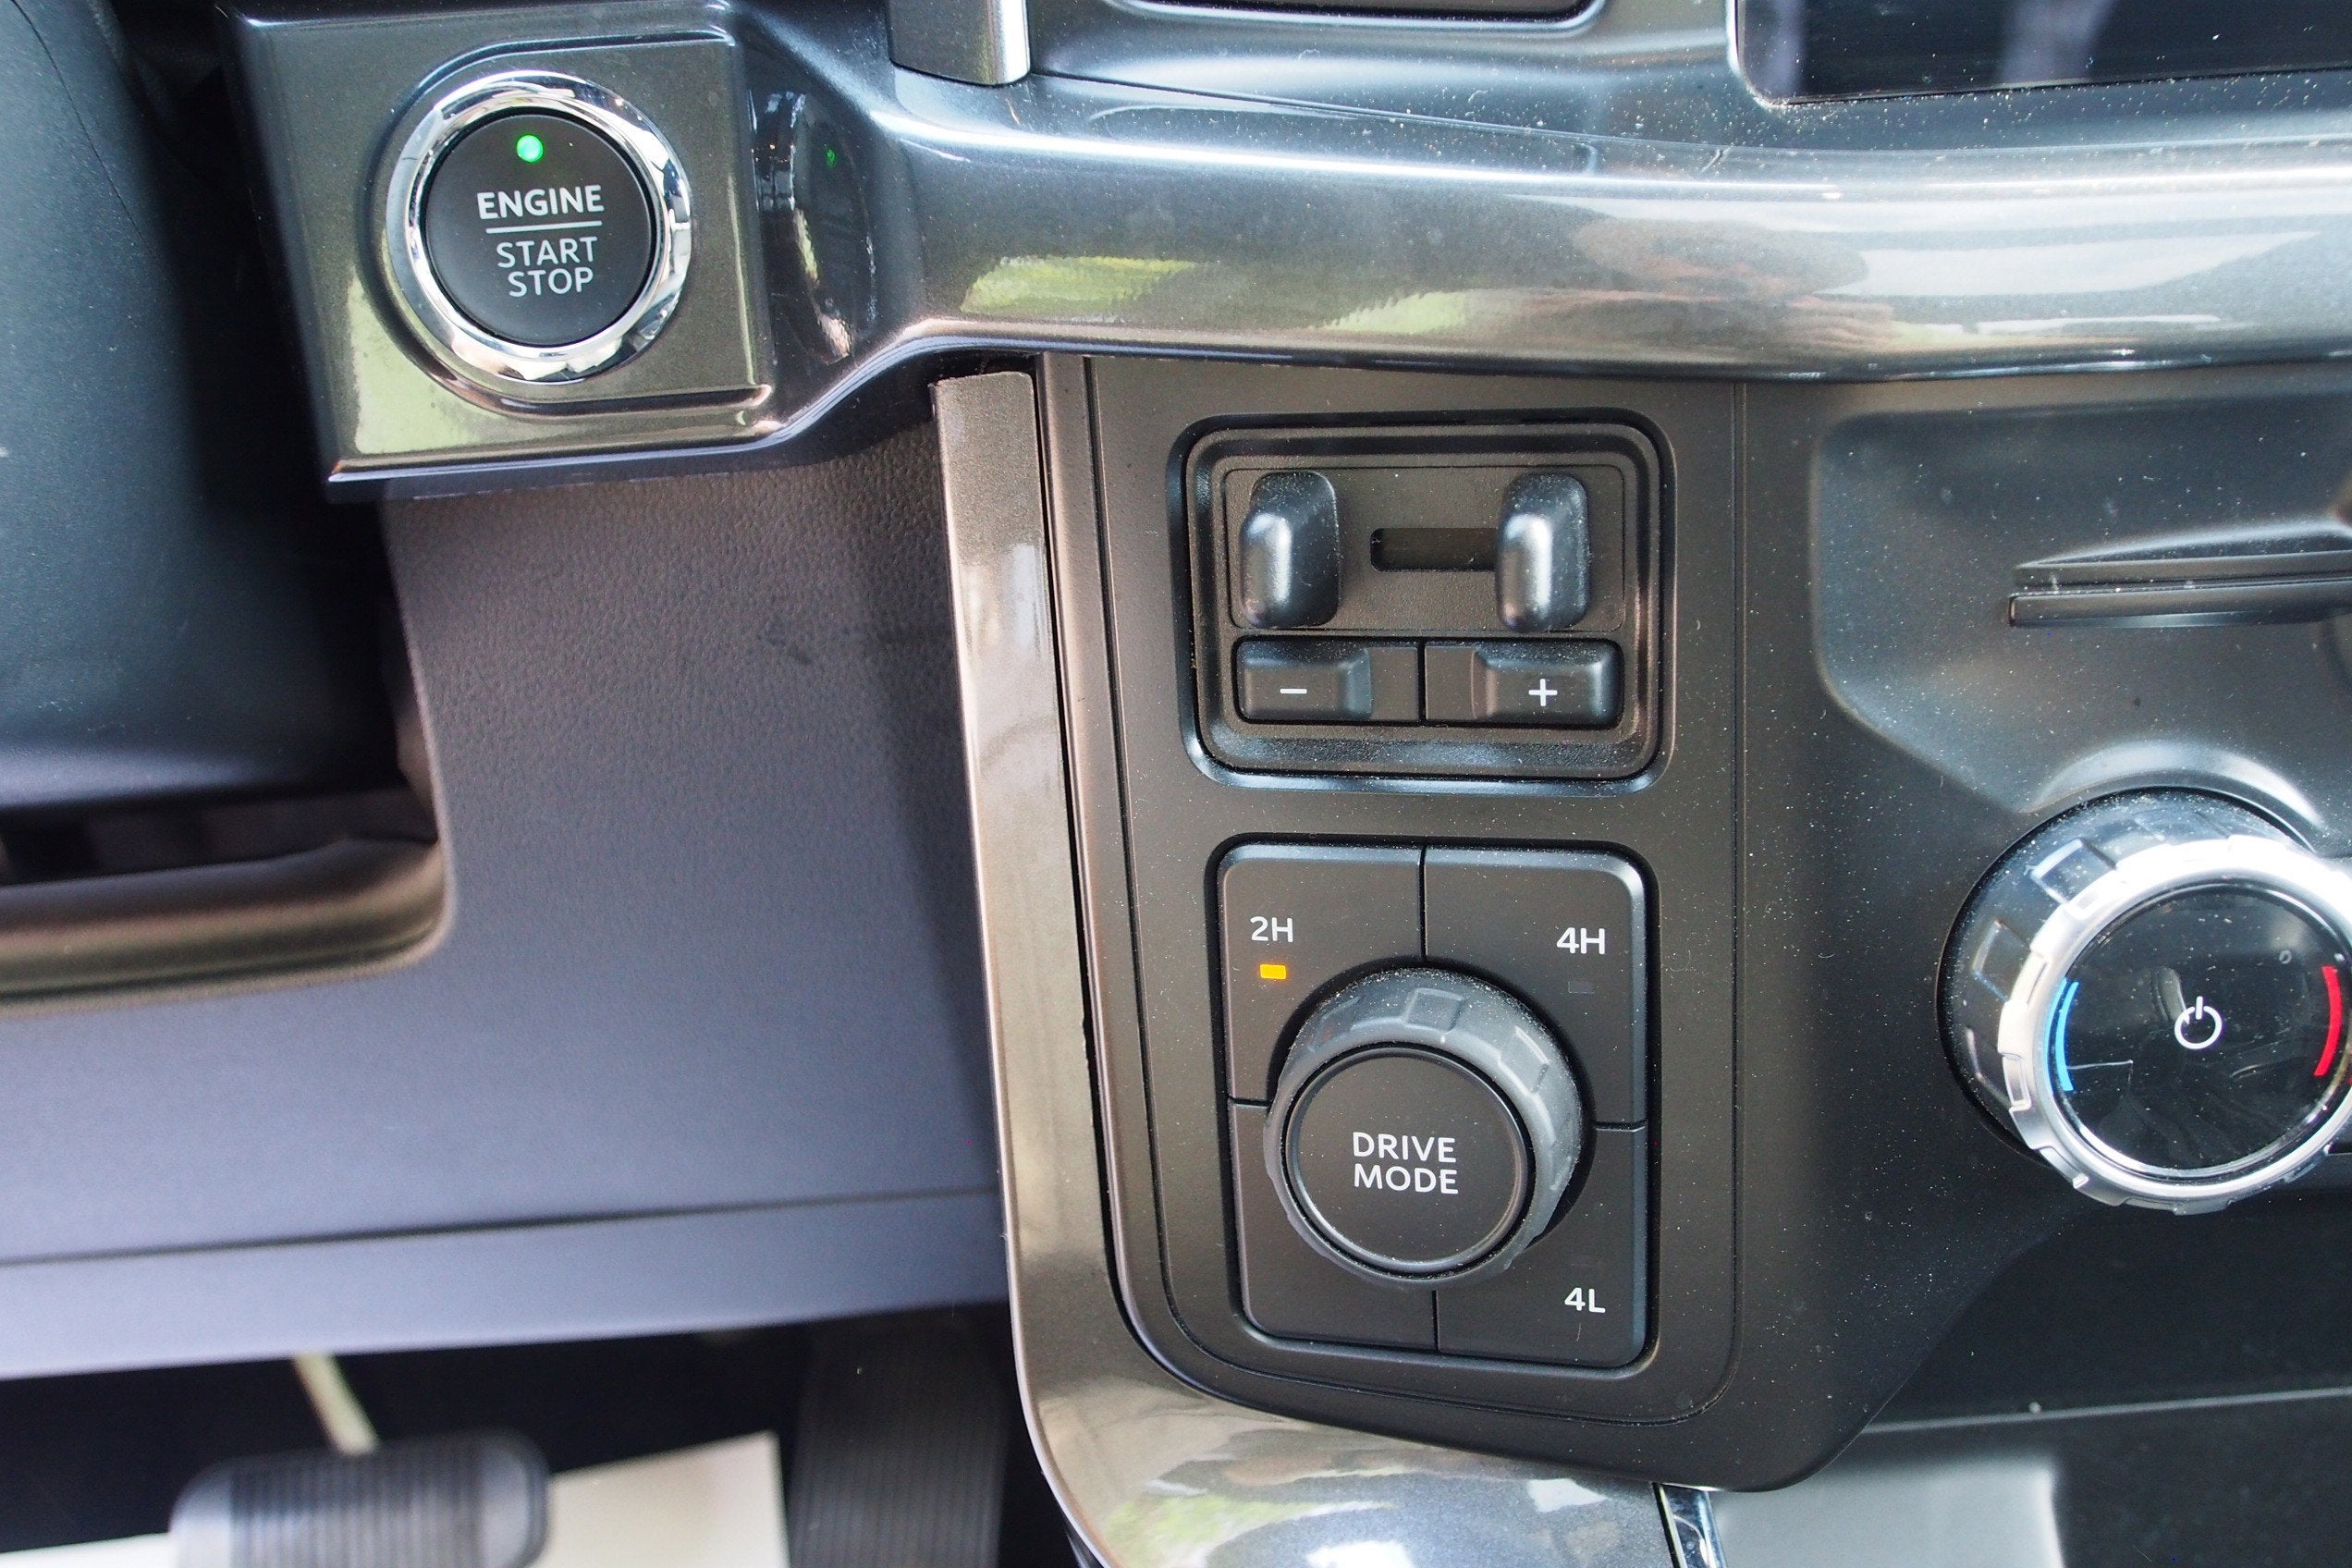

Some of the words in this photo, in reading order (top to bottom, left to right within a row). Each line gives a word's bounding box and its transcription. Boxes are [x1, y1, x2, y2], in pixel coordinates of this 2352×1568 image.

[476, 185, 605, 220] ENGINE
[496, 236, 598, 268] START
[508, 267, 594, 298] STOP
[1249, 915, 1294, 943] 2H
[1556, 926, 1606, 955] 4H
[1352, 1132, 1457, 1164] DRIVE
[1354, 1163, 1459, 1194] MODE
[1564, 1287, 1606, 1314] 4L
